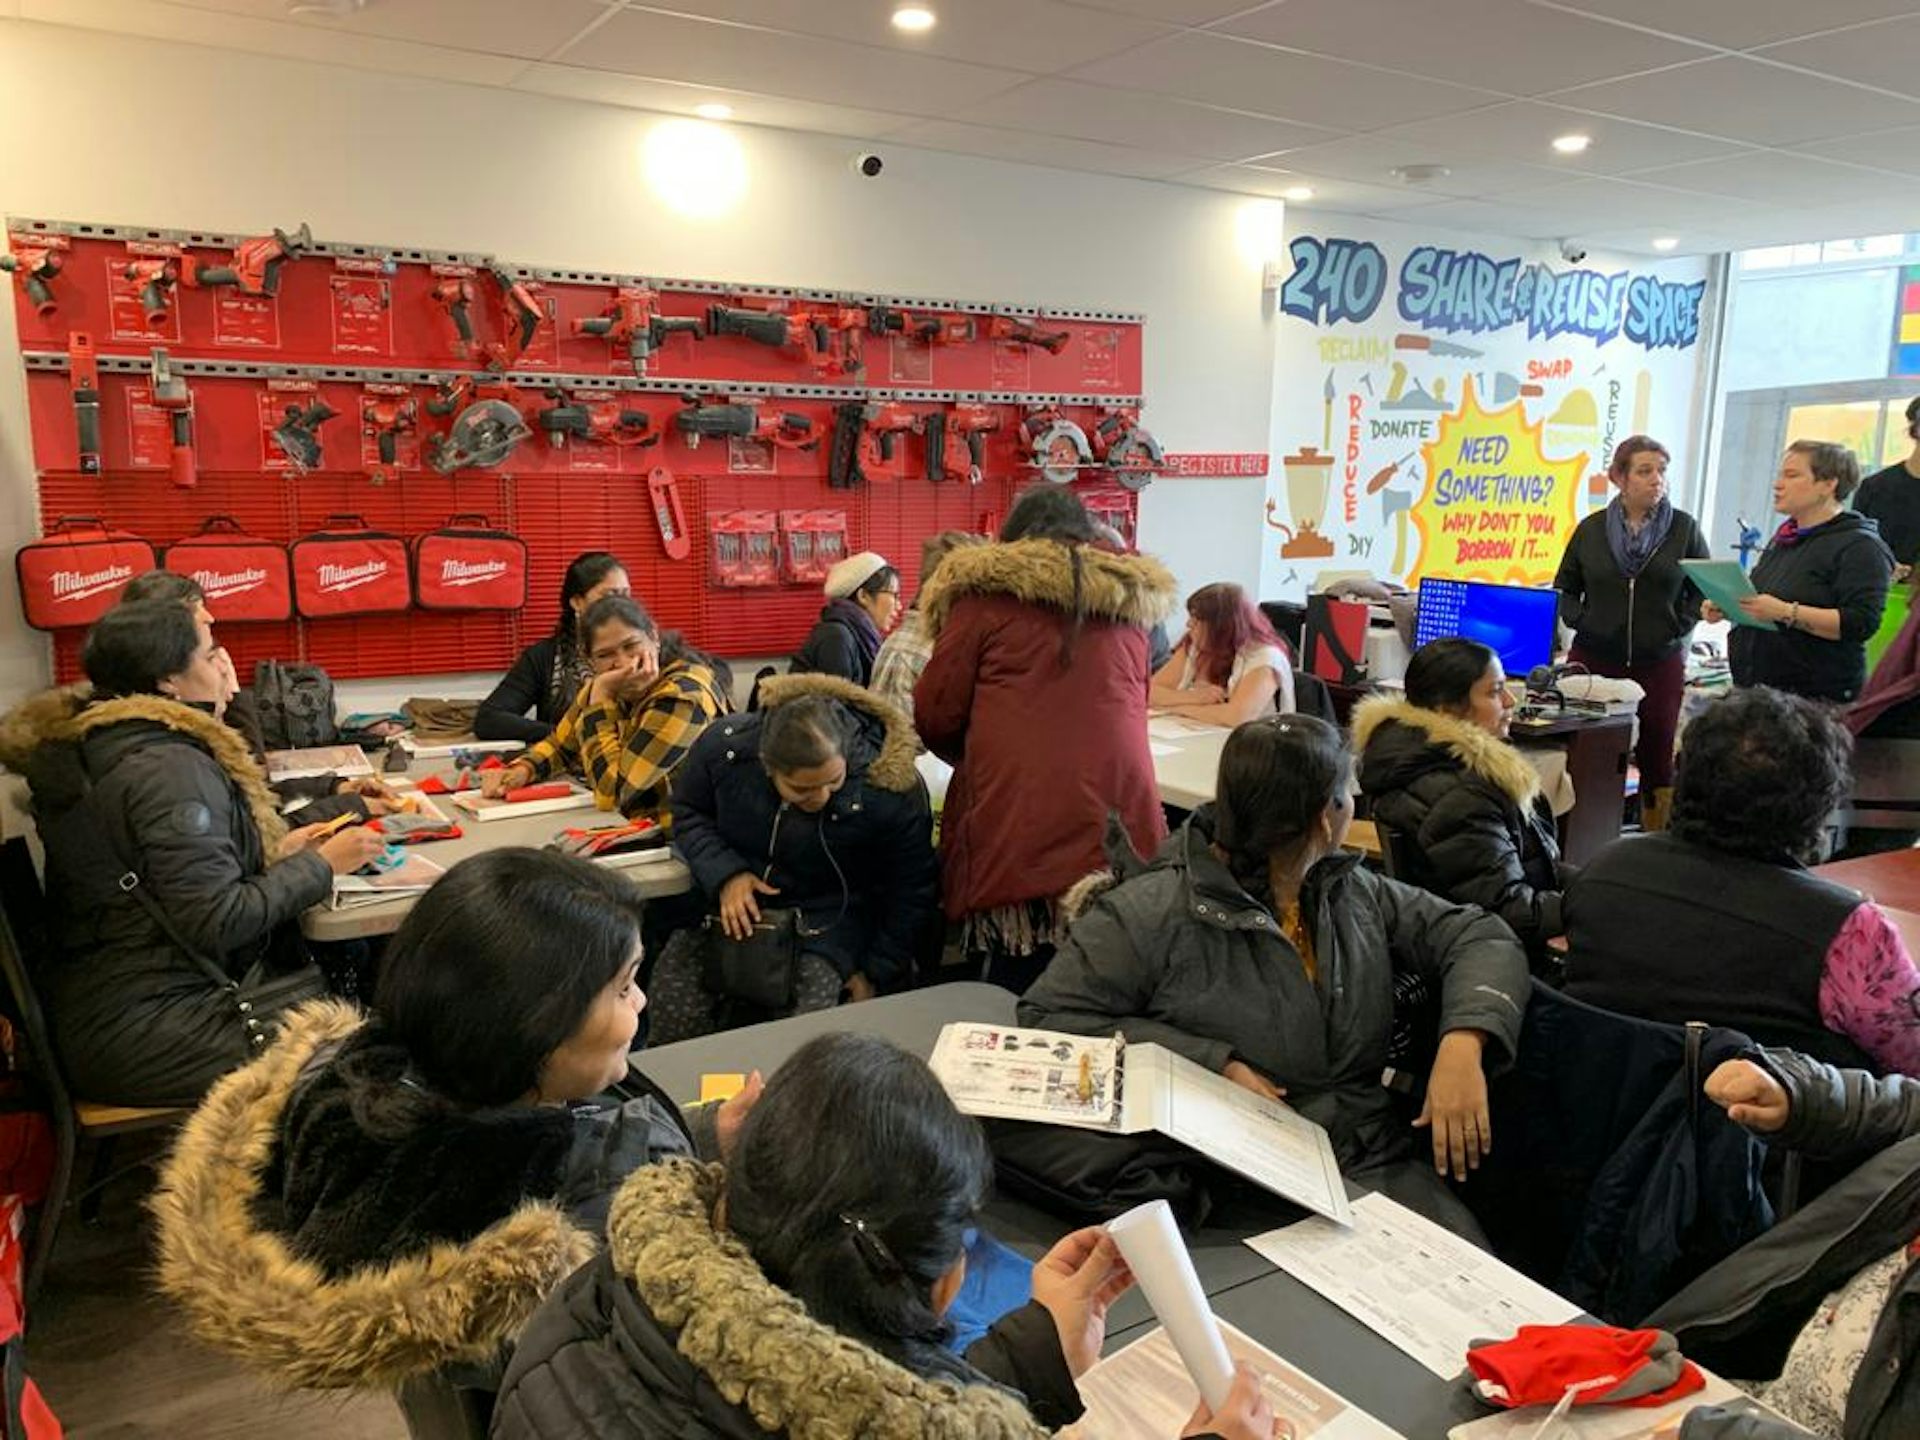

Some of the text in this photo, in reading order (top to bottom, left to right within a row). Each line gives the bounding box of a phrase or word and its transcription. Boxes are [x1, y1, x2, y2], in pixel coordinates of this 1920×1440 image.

[1281, 236, 1387, 326] 240
[1398, 247, 1520, 334] SHARE
[1529, 263, 1629, 348] REUSE
[1624, 275, 1706, 351] SPACE
[1318, 335, 1389, 364] RECLAIM
[1527, 358, 1573, 380] SWAP
[1370, 420, 1432, 439] DONATE
[1344, 393, 1362, 523] REDUCE
[1457, 435, 1509, 465] NEED
[1434, 468, 1554, 506] SOMETHING?
[1442, 510, 1556, 535] WHY DONT YOU
[1348, 534, 1373, 558] DIY
[1455, 538, 1516, 564] BORROW
[50, 564, 132, 595] Milwaukee
[192, 567, 267, 589] Milwaukee
[317, 560, 388, 586] Milwaukee
[440, 556, 506, 579] Milwaukee
